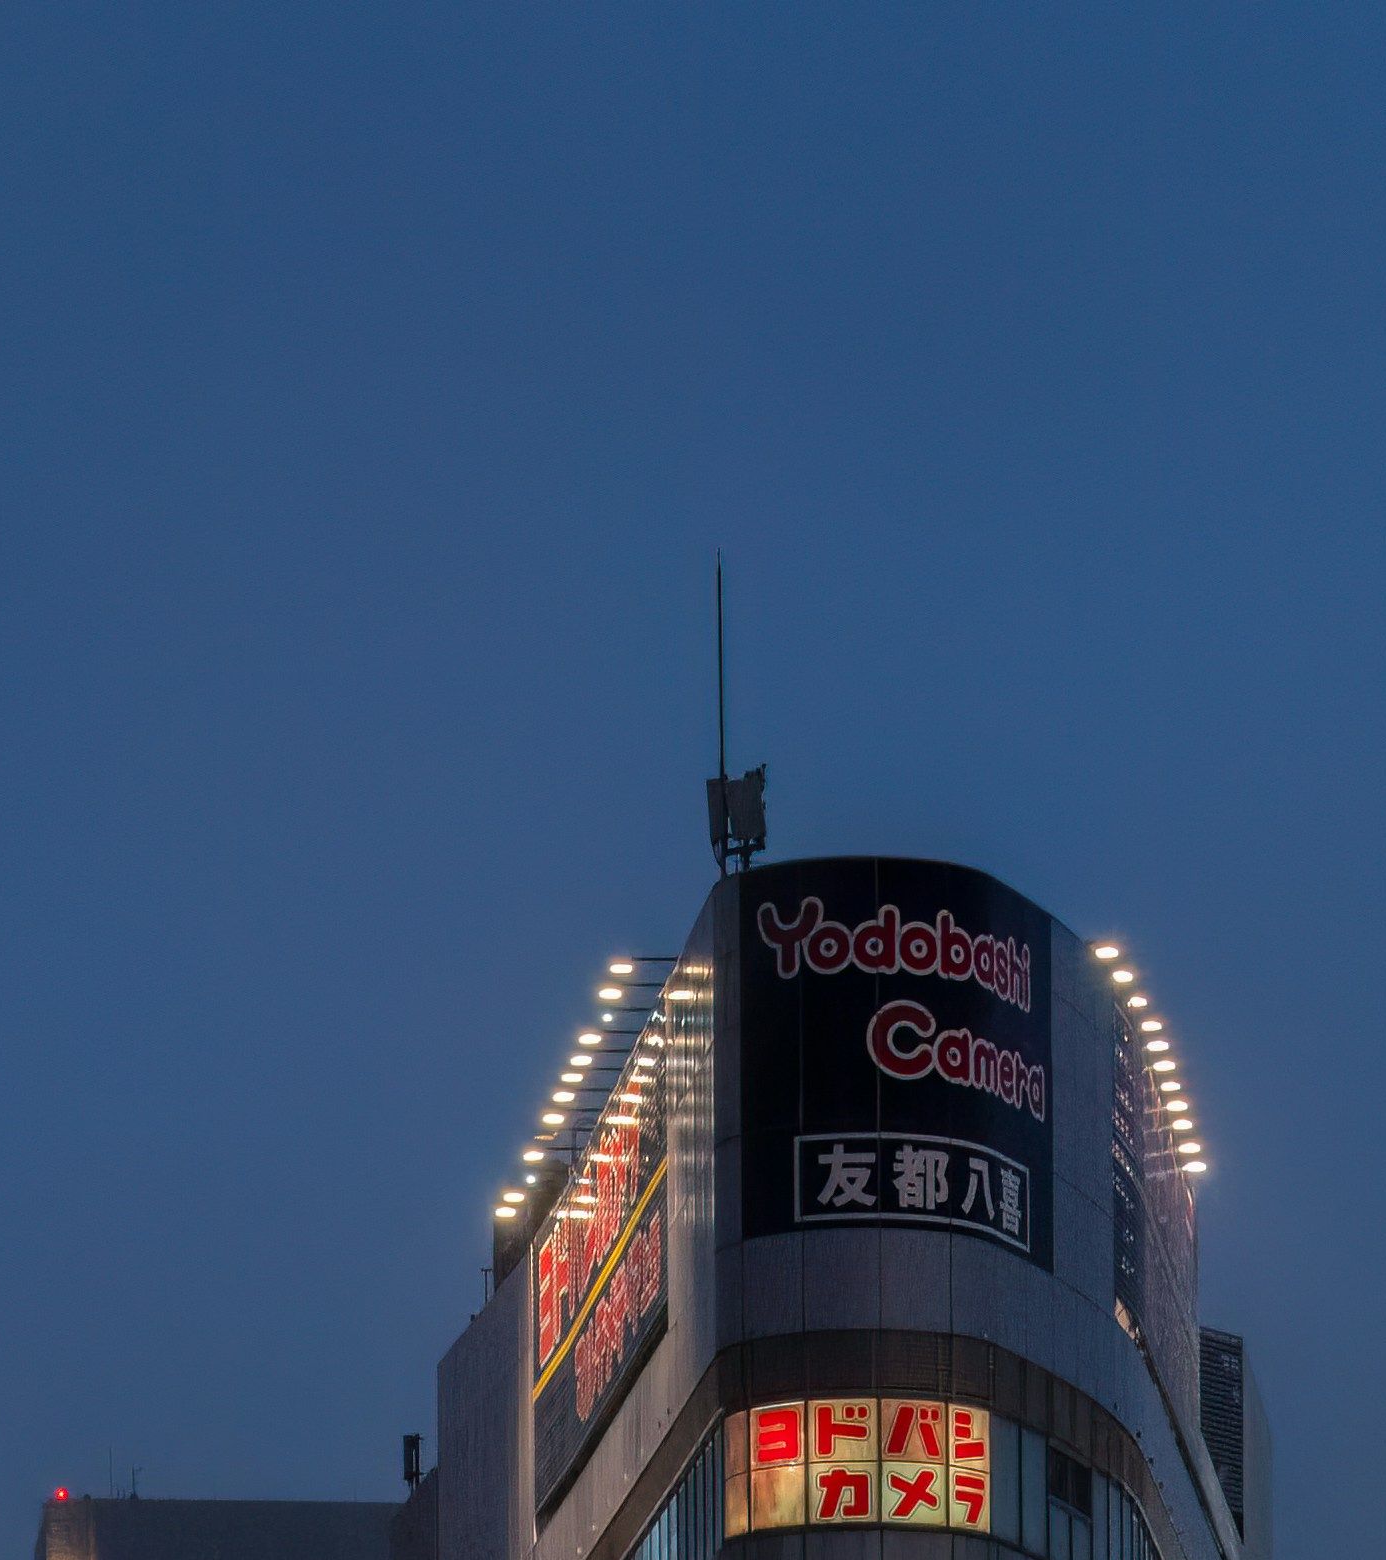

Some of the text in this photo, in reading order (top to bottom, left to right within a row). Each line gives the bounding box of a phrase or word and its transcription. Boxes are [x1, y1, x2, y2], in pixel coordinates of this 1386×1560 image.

[757, 895, 1032, 1014] Yodobashi
[866, 999, 1044, 1123] Camera
[816, 1143, 1022, 1235] 友都八喜
[757, 1401, 985, 1464] ヨドバシ
[816, 1470, 988, 1525] カメラ
